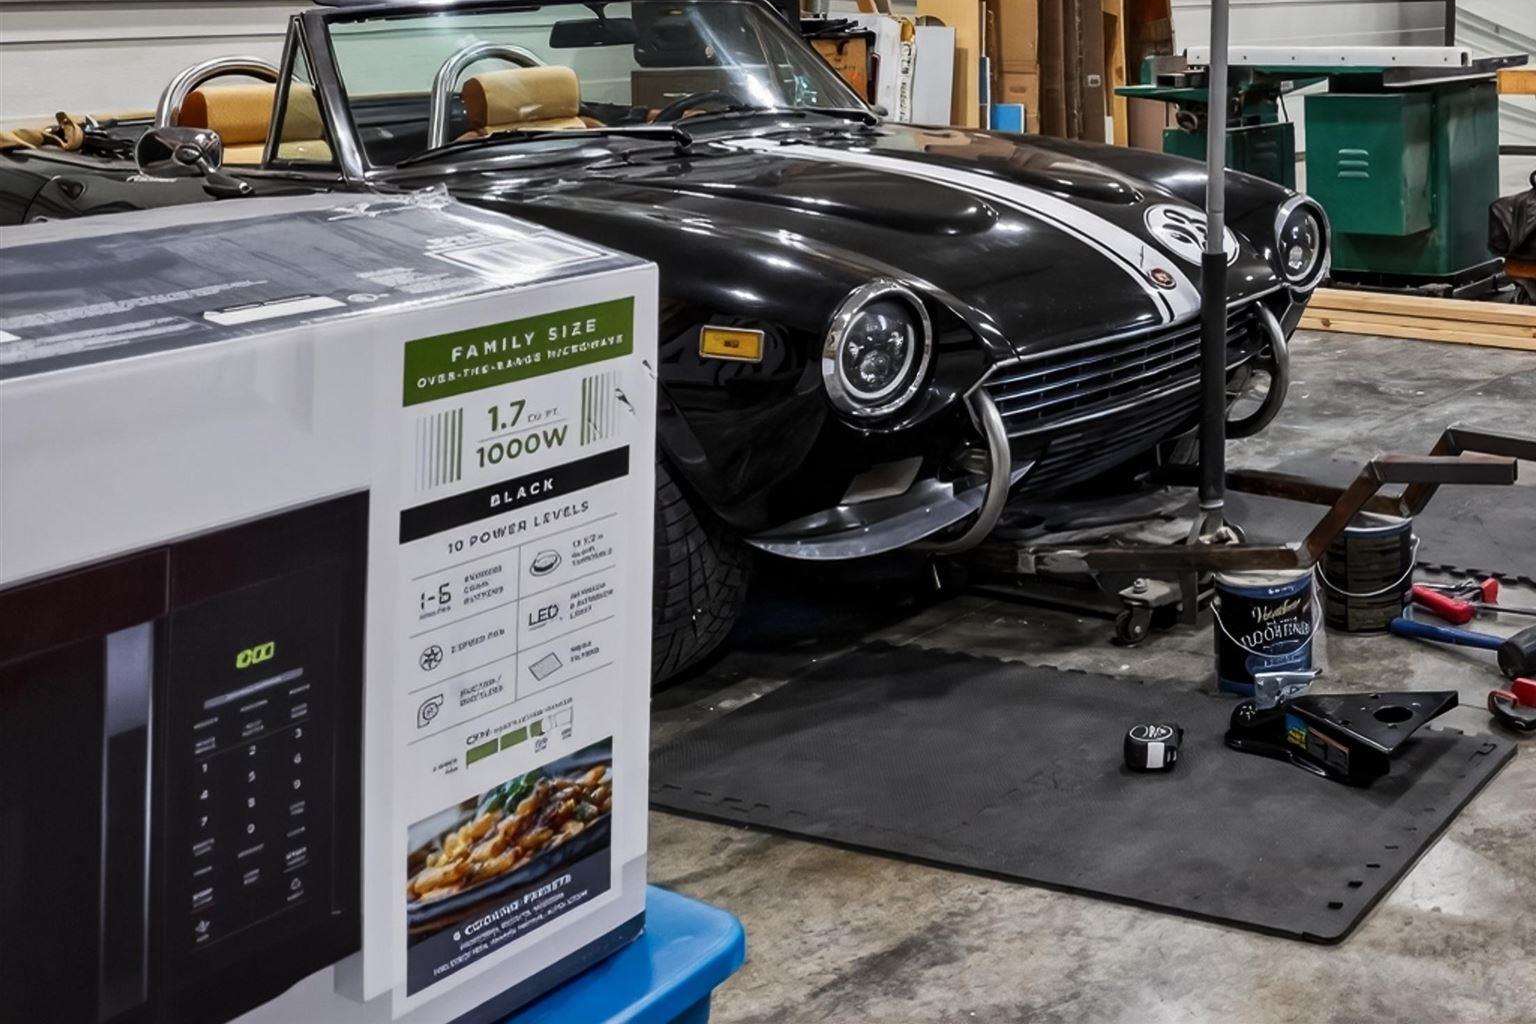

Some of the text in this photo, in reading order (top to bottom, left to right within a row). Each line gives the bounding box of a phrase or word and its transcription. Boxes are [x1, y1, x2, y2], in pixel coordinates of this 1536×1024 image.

[451, 318, 597, 362] FAMILY SIZE
[487, 398, 527, 432] 1.7
[475, 424, 568, 468] 1000W
[489, 478, 555, 508] BLACK
[448, 501, 590, 554] 10 POWER LEVELS
[528, 603, 559, 626] LED
